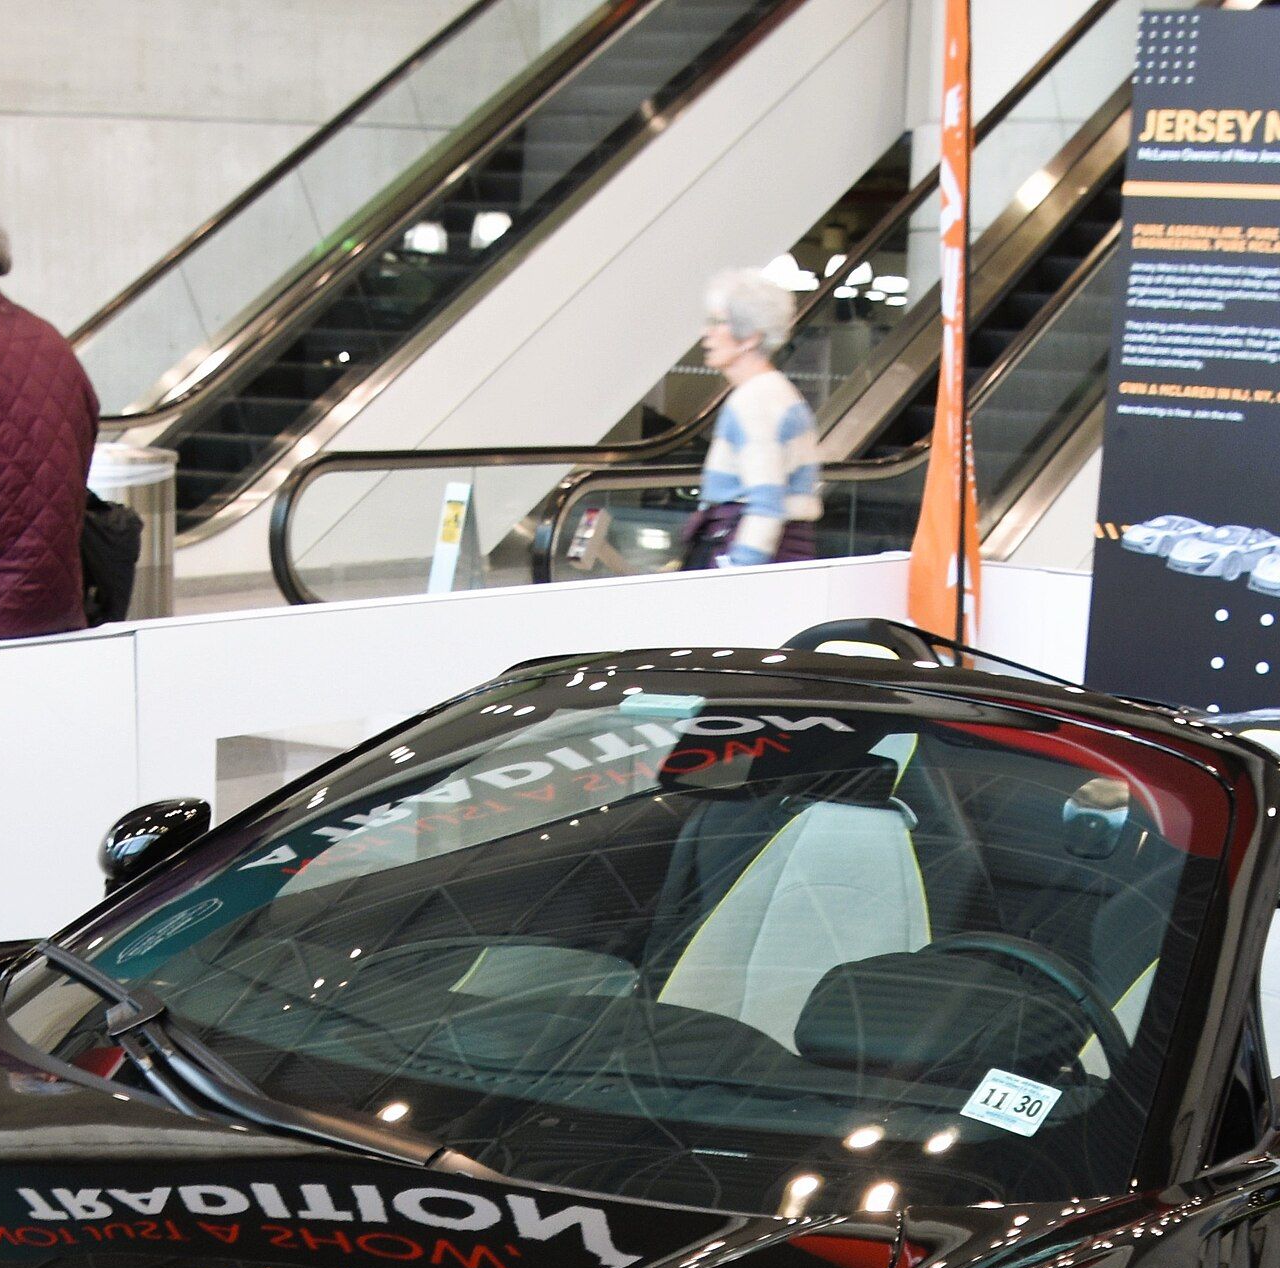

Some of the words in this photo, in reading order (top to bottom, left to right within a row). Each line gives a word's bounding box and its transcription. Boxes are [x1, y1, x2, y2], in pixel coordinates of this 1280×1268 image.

[1138, 108, 1262, 144] JERSEY
[980, 1087, 1010, 1110] 11
[1013, 1095, 1043, 1117] 30
